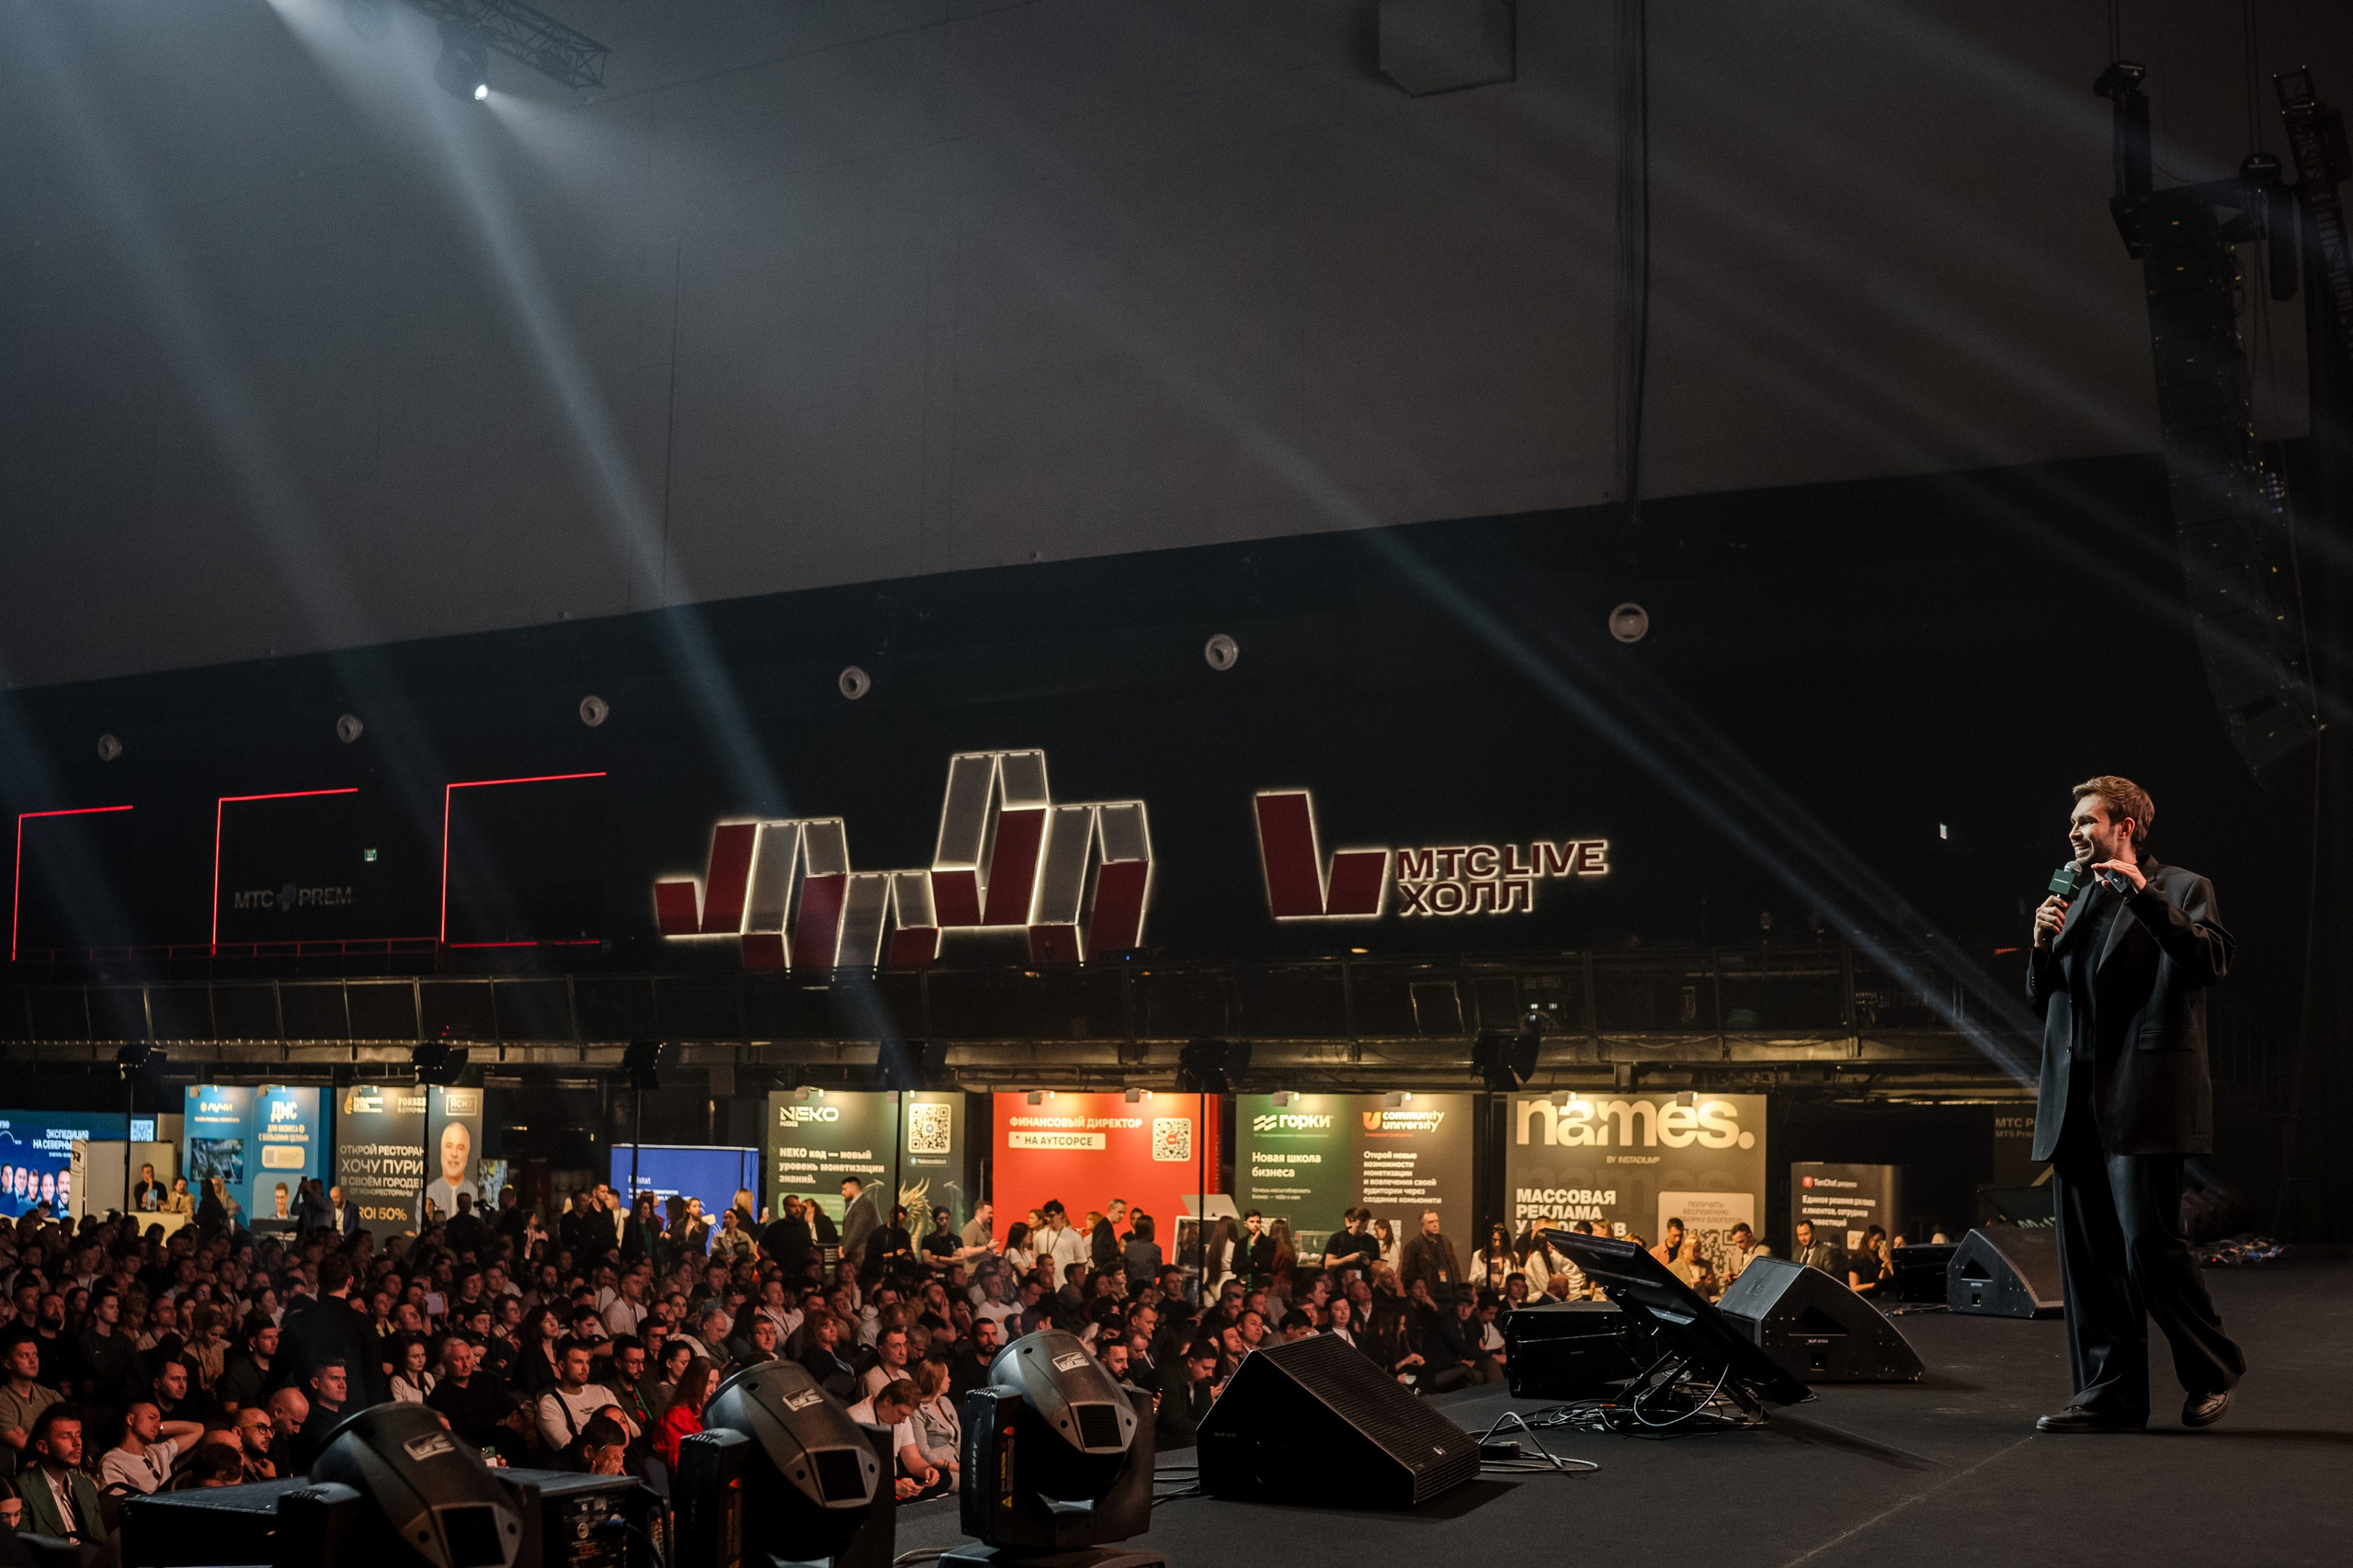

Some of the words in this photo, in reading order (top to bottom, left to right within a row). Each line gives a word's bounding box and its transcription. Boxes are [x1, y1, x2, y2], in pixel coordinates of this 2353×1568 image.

[1505, 840, 1608, 876] LIVE
[1399, 879, 1533, 916] ХОЛЛ
[270, 1101, 298, 1122] ДМС
[779, 1106, 840, 1121] NEKO
[1381, 1110, 1445, 1122] community
[1009, 1116, 1086, 1128] ФИНАНСОВЫЙ
[1086, 1118, 1143, 1130] ДИРЕКТОР
[1381, 1119, 1439, 1132] university
[1517, 1099, 1755, 1150] names.
[46, 1129, 89, 1141] ЭКСПЕДИЦИЯ
[1025, 1136, 1038, 1145] НА
[1040, 1137, 1093, 1146] АУТСОРСЕ
[32, 1139, 43, 1150] НА
[43, 1140, 73, 1151] СЕВЕРНЫ
[339, 1142, 378, 1155] ОТКРОЙ
[779, 1147, 808, 1158] NEKO
[809, 1150, 827, 1160] код
[840, 1149, 872, 1160] новый
[1252, 1152, 1285, 1163] Новая
[1286, 1153, 1322, 1163] школа
[341, 1158, 381, 1174] ХОЧУ
[382, 1159, 424, 1176] ПУРИ
[779, 1162, 819, 1172] уровень
[820, 1164, 885, 1175] монетизации
[1252, 1165, 1296, 1177] бизнеса
[341, 1176, 347, 1186] В
[348, 1175, 382, 1187] СВОЁМ
[382, 1177, 420, 1189] ГОРОДЕ
[779, 1174, 816, 1184] знаний.
[1516, 1188, 1617, 1205] МАССОВАЯ
[378, 1207, 408, 1221] 50%
[1516, 1204, 1603, 1220] РЕКЛАМА
[1515, 1220, 1528, 1234] У
